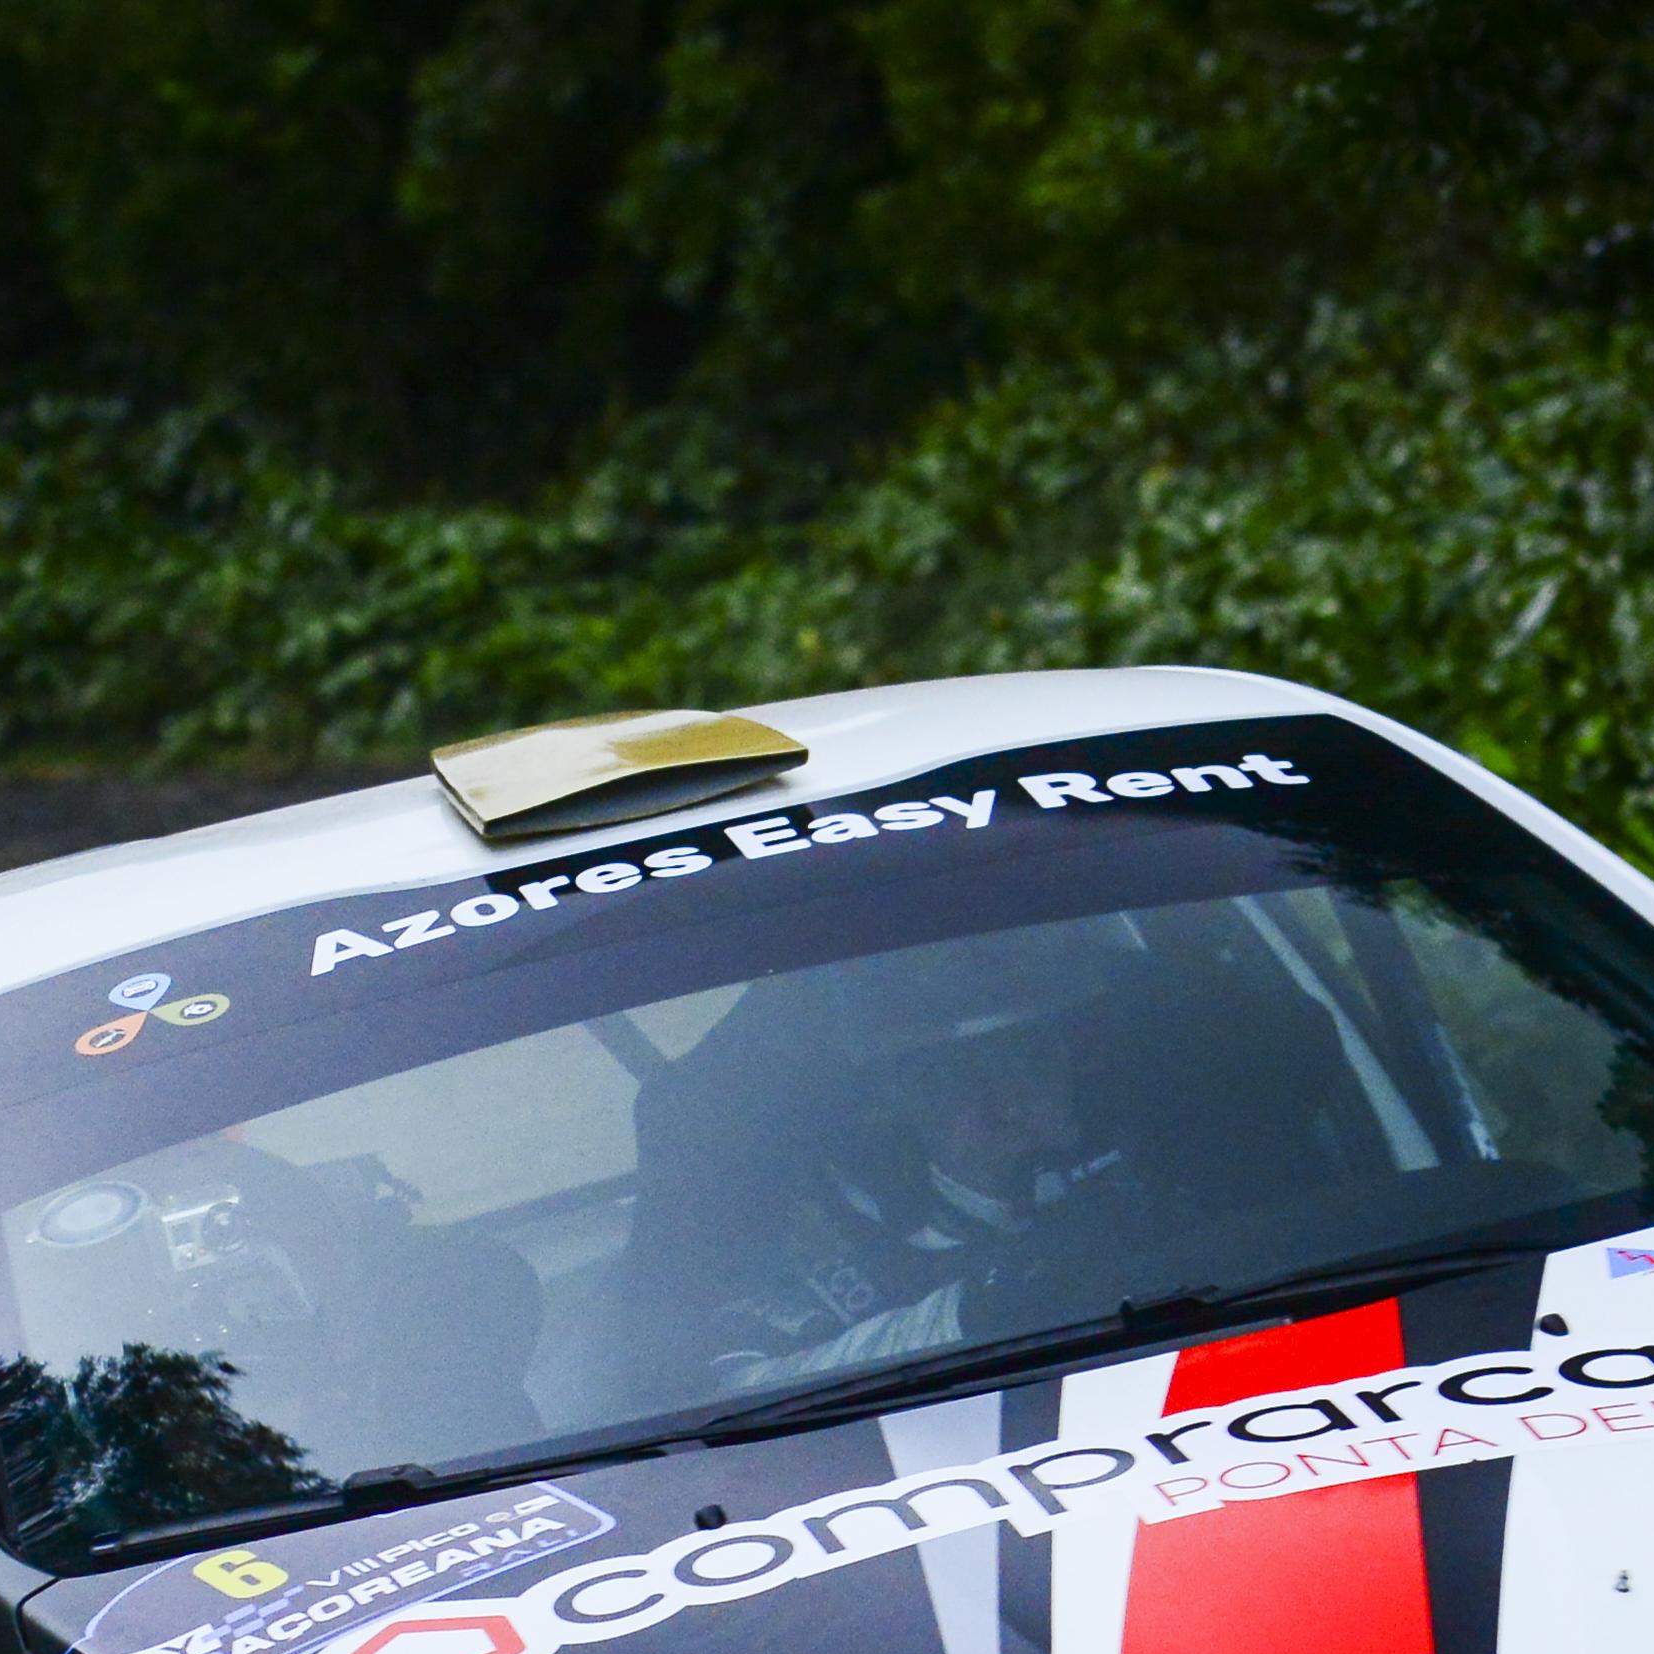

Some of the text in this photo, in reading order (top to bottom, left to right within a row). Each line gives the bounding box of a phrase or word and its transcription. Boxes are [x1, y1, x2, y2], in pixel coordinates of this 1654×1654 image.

[310, 753, 1311, 977] Azores Easy Rent
[1154, 1428, 1499, 1507] PONTA
[192, 1549, 289, 1599] 6
